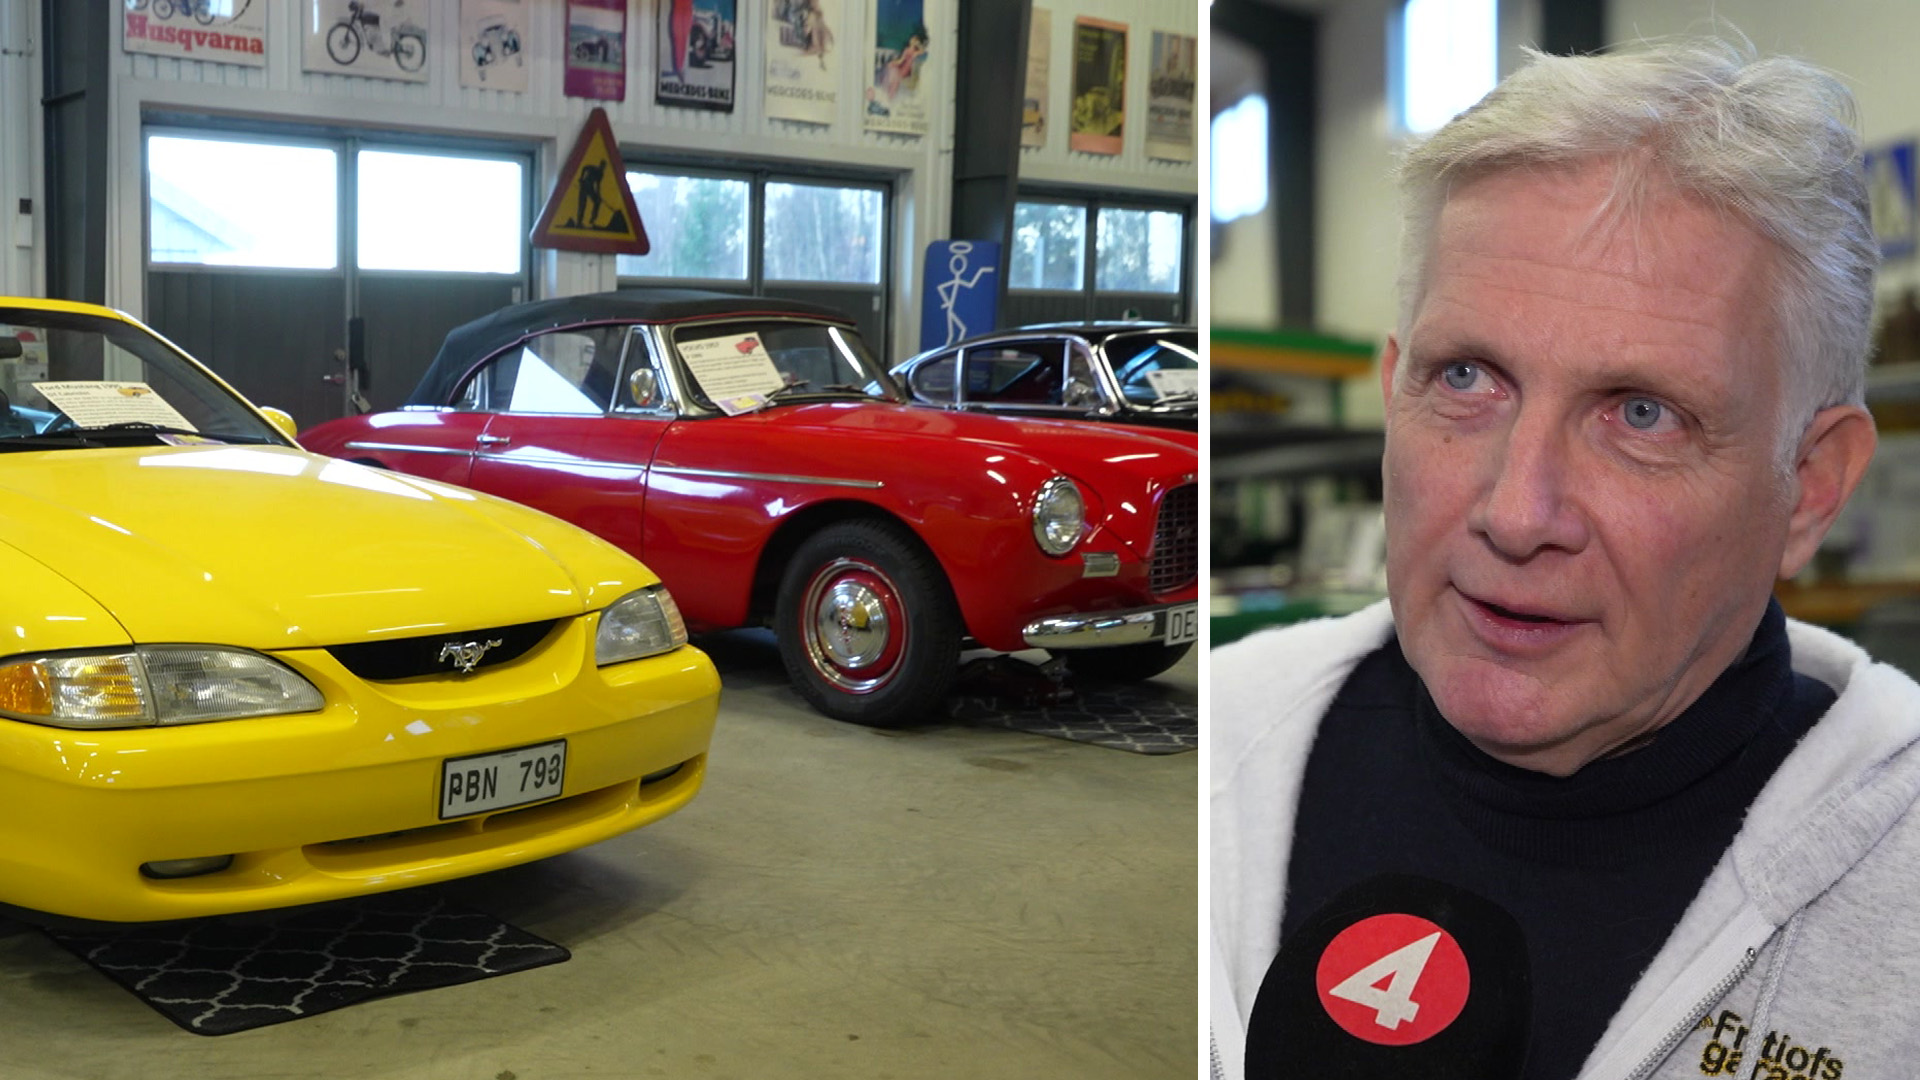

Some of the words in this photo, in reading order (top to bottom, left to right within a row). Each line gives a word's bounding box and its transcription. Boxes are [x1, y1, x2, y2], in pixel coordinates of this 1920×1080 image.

[126, 14, 264, 54] Husqvarna
[448, 765, 498, 806] PBN
[519, 753, 562, 792] 793
[1328, 931, 1442, 1031] 4
[1713, 1010, 1843, 1080] Frtiofs
